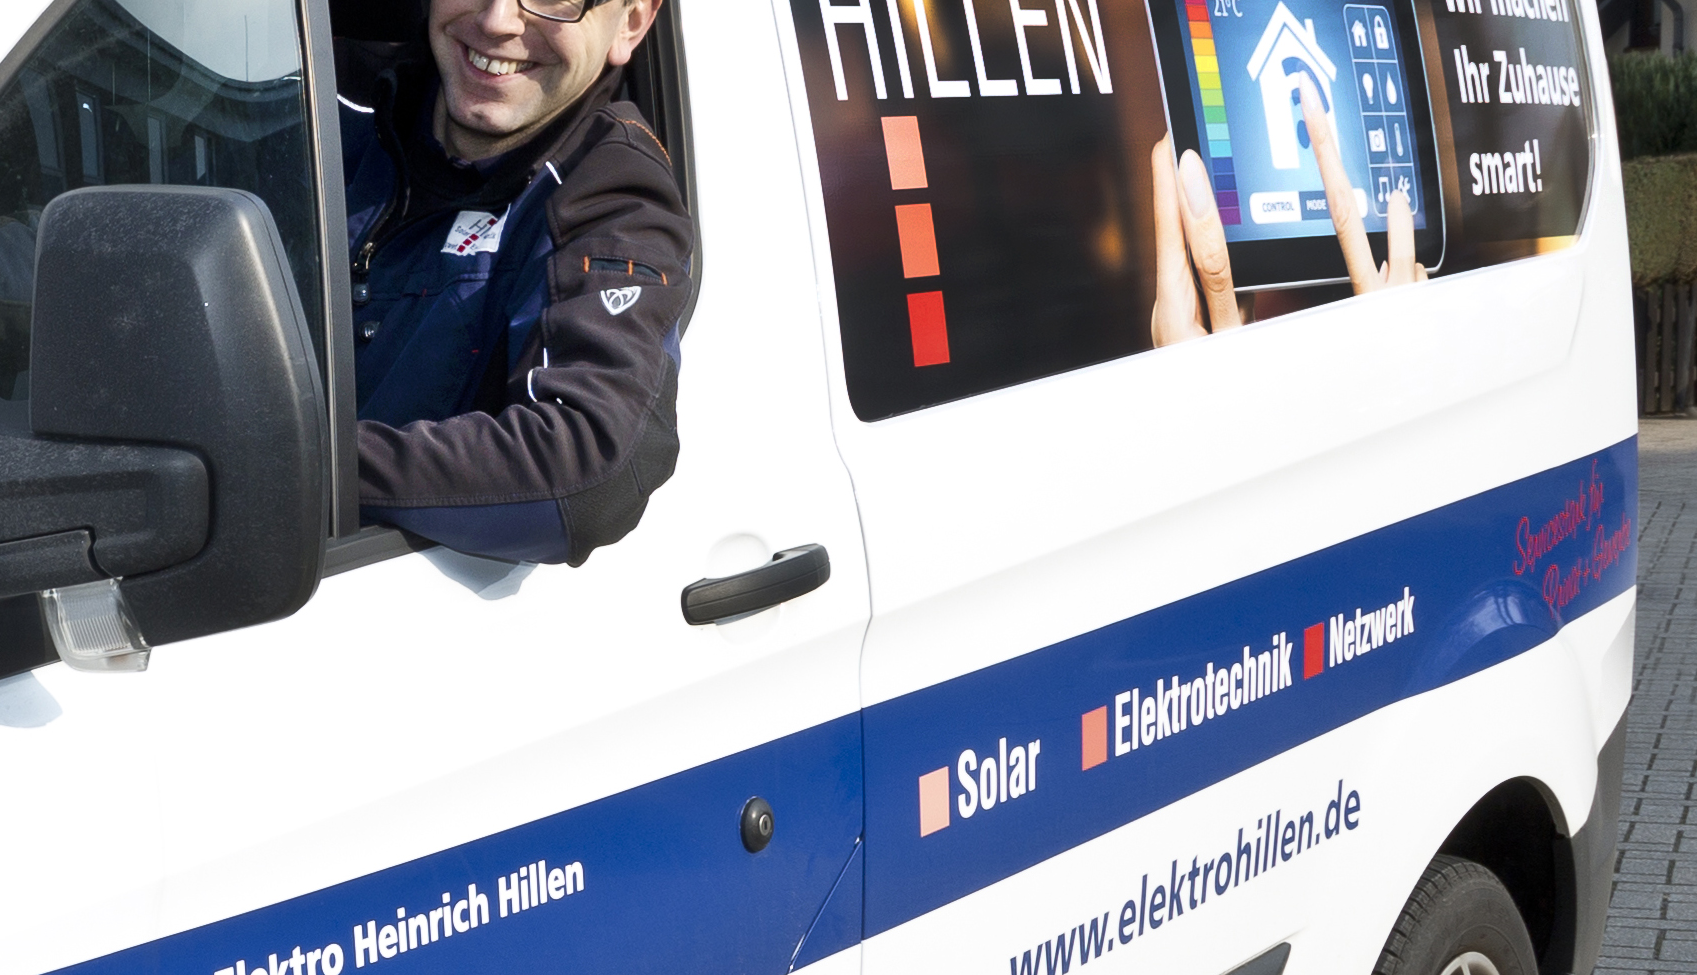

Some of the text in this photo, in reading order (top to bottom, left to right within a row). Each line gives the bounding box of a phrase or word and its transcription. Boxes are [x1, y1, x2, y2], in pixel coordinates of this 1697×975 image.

[1453, 44, 1580, 107] Ihr Zuhause
[1262, 198, 1328, 213] CONTROL MODE
[1469, 138, 1543, 195] smart!
[957, 586, 1416, 819] Solar Elektrotechnik Netzwerk
[353, 883, 490, 969] Heinrich
[497, 859, 585, 918] Hillen
[1008, 779, 1362, 975] www.elektrohillen.de
